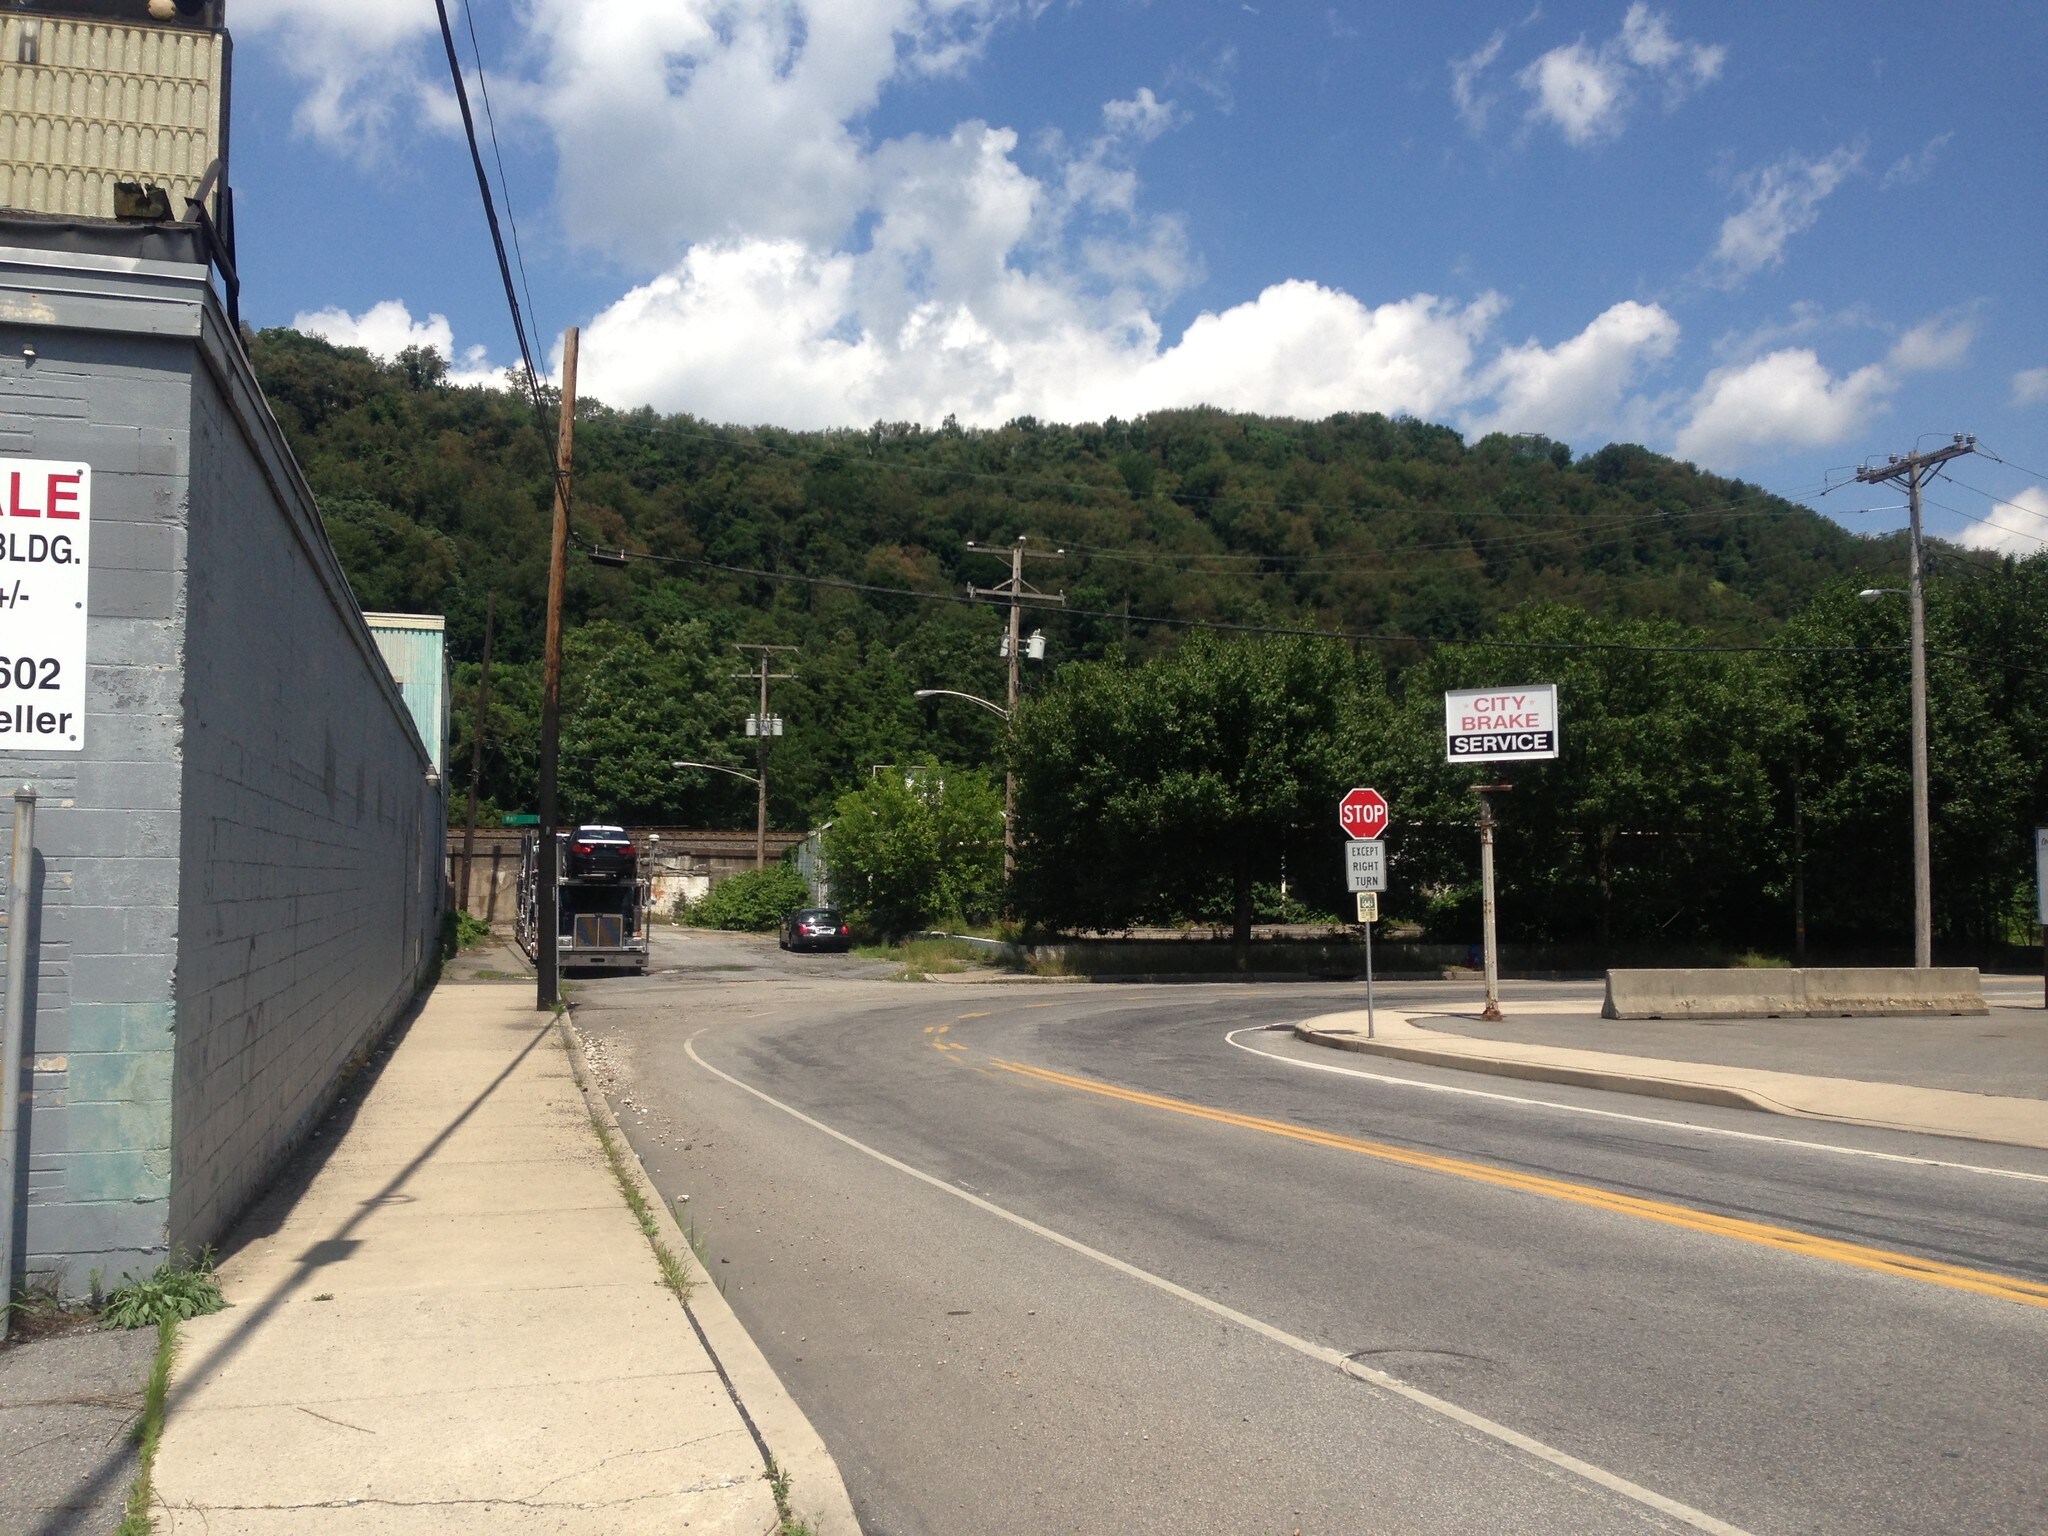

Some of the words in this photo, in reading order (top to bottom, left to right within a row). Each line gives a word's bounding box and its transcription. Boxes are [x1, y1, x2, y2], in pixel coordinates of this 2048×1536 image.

[0, 471, 80, 520] LE
[1473, 695, 1526, 713] CITY
[1461, 713, 1540, 731] BRAKE
[1454, 733, 1548, 753] SERVICE
[1343, 804, 1385, 824] STOP
[1351, 846, 1379, 857] EXCEPT
[1352, 861, 1379, 872] RIGHT
[1355, 876, 1379, 886] TURN
